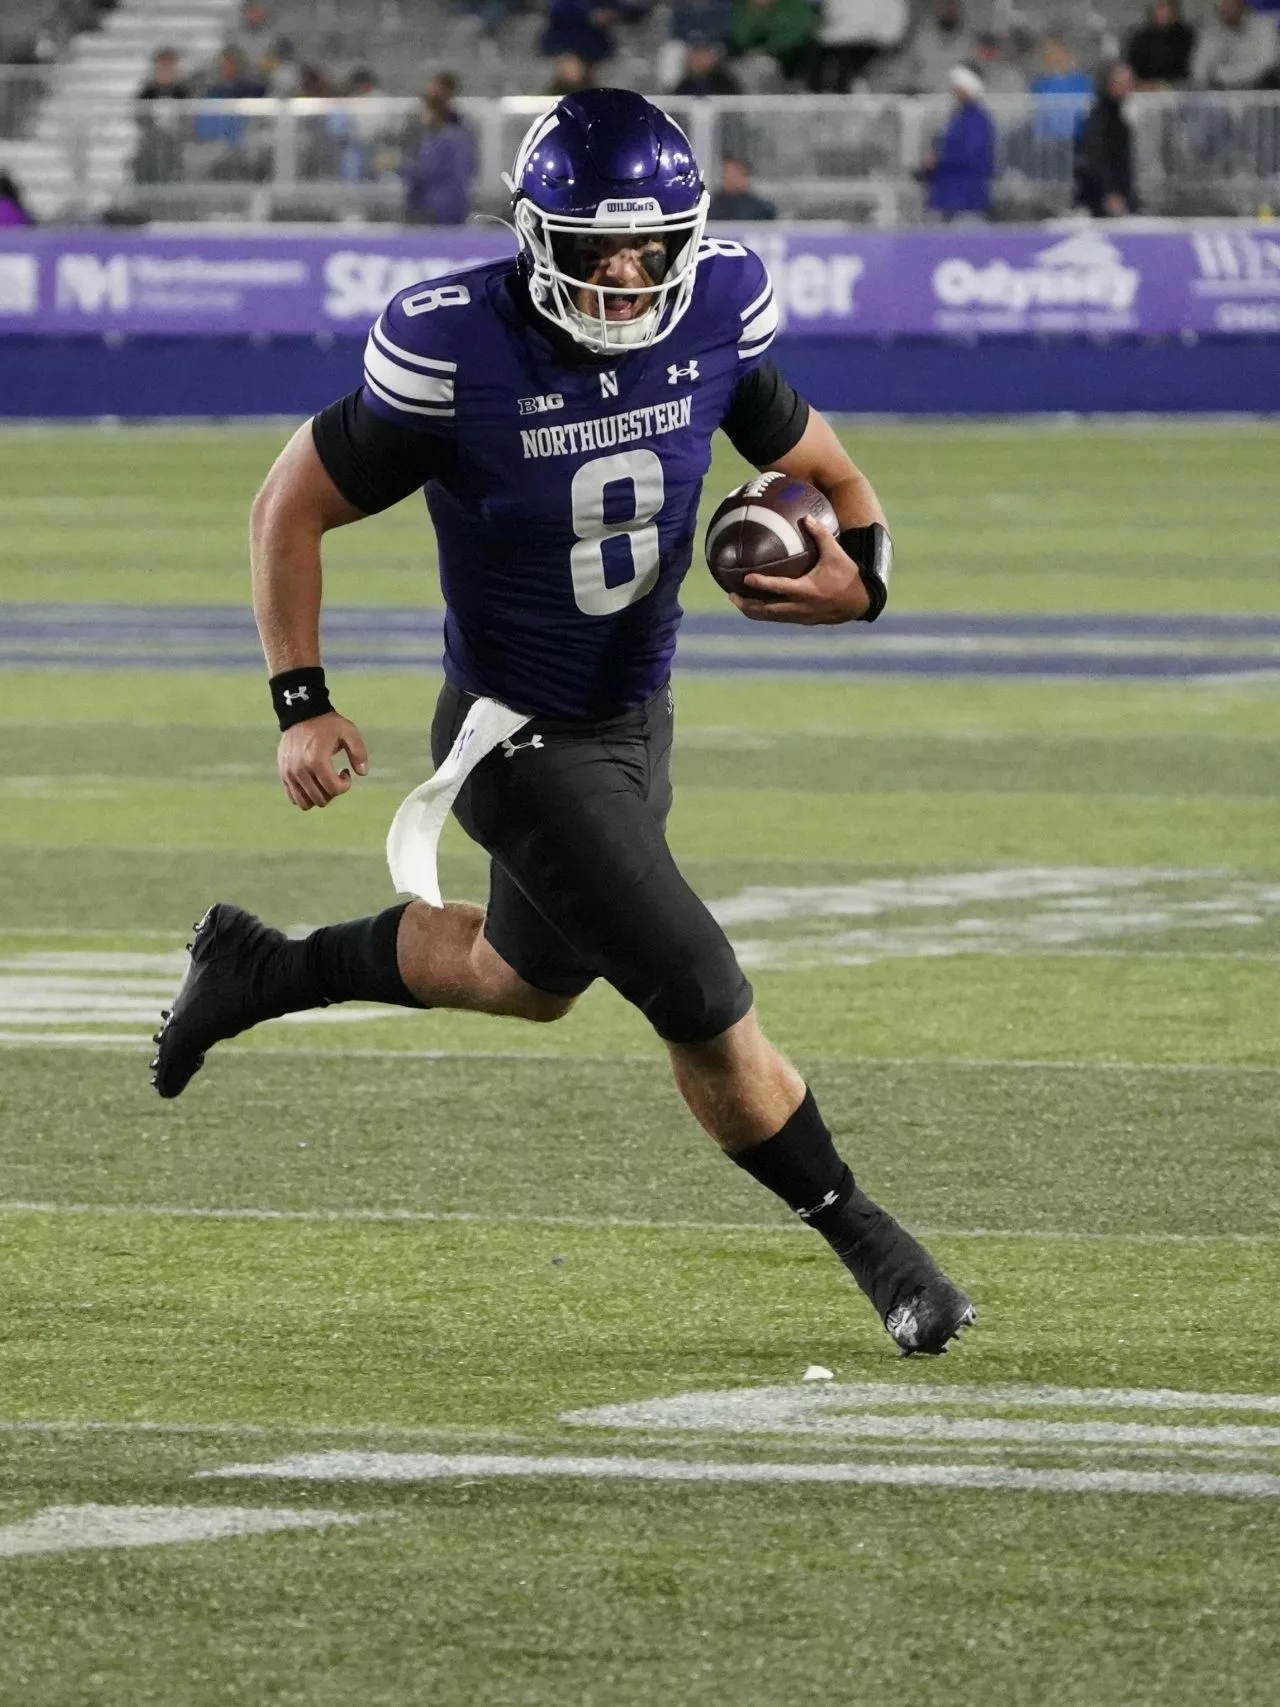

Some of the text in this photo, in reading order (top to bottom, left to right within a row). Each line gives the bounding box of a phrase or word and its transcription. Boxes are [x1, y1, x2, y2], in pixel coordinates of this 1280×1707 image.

[606, 202, 655, 213] WILDCATS
[402, 285, 470, 317] 8
[599, 371, 620, 399] N
[520, 395, 693, 459] NORTHWESTERN
[570, 449, 665, 616] 8
